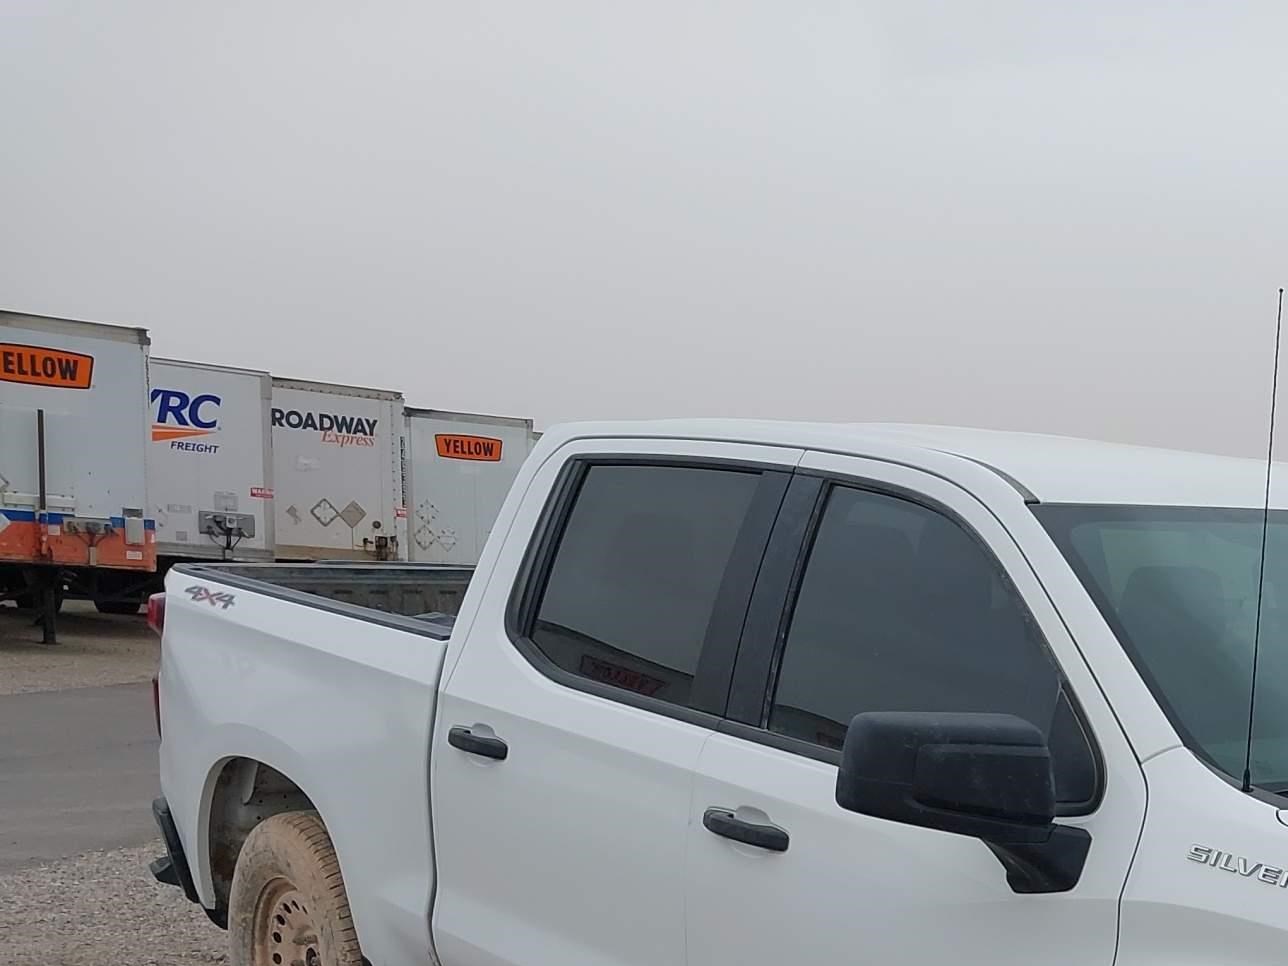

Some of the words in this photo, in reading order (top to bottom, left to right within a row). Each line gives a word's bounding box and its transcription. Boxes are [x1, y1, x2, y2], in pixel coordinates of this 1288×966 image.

[2, 351, 79, 381] ELLOW
[271, 407, 378, 437] ROADWAY
[170, 440, 220, 454] FREIGHT
[320, 430, 376, 448] Express
[443, 438, 494, 457] YELLOW
